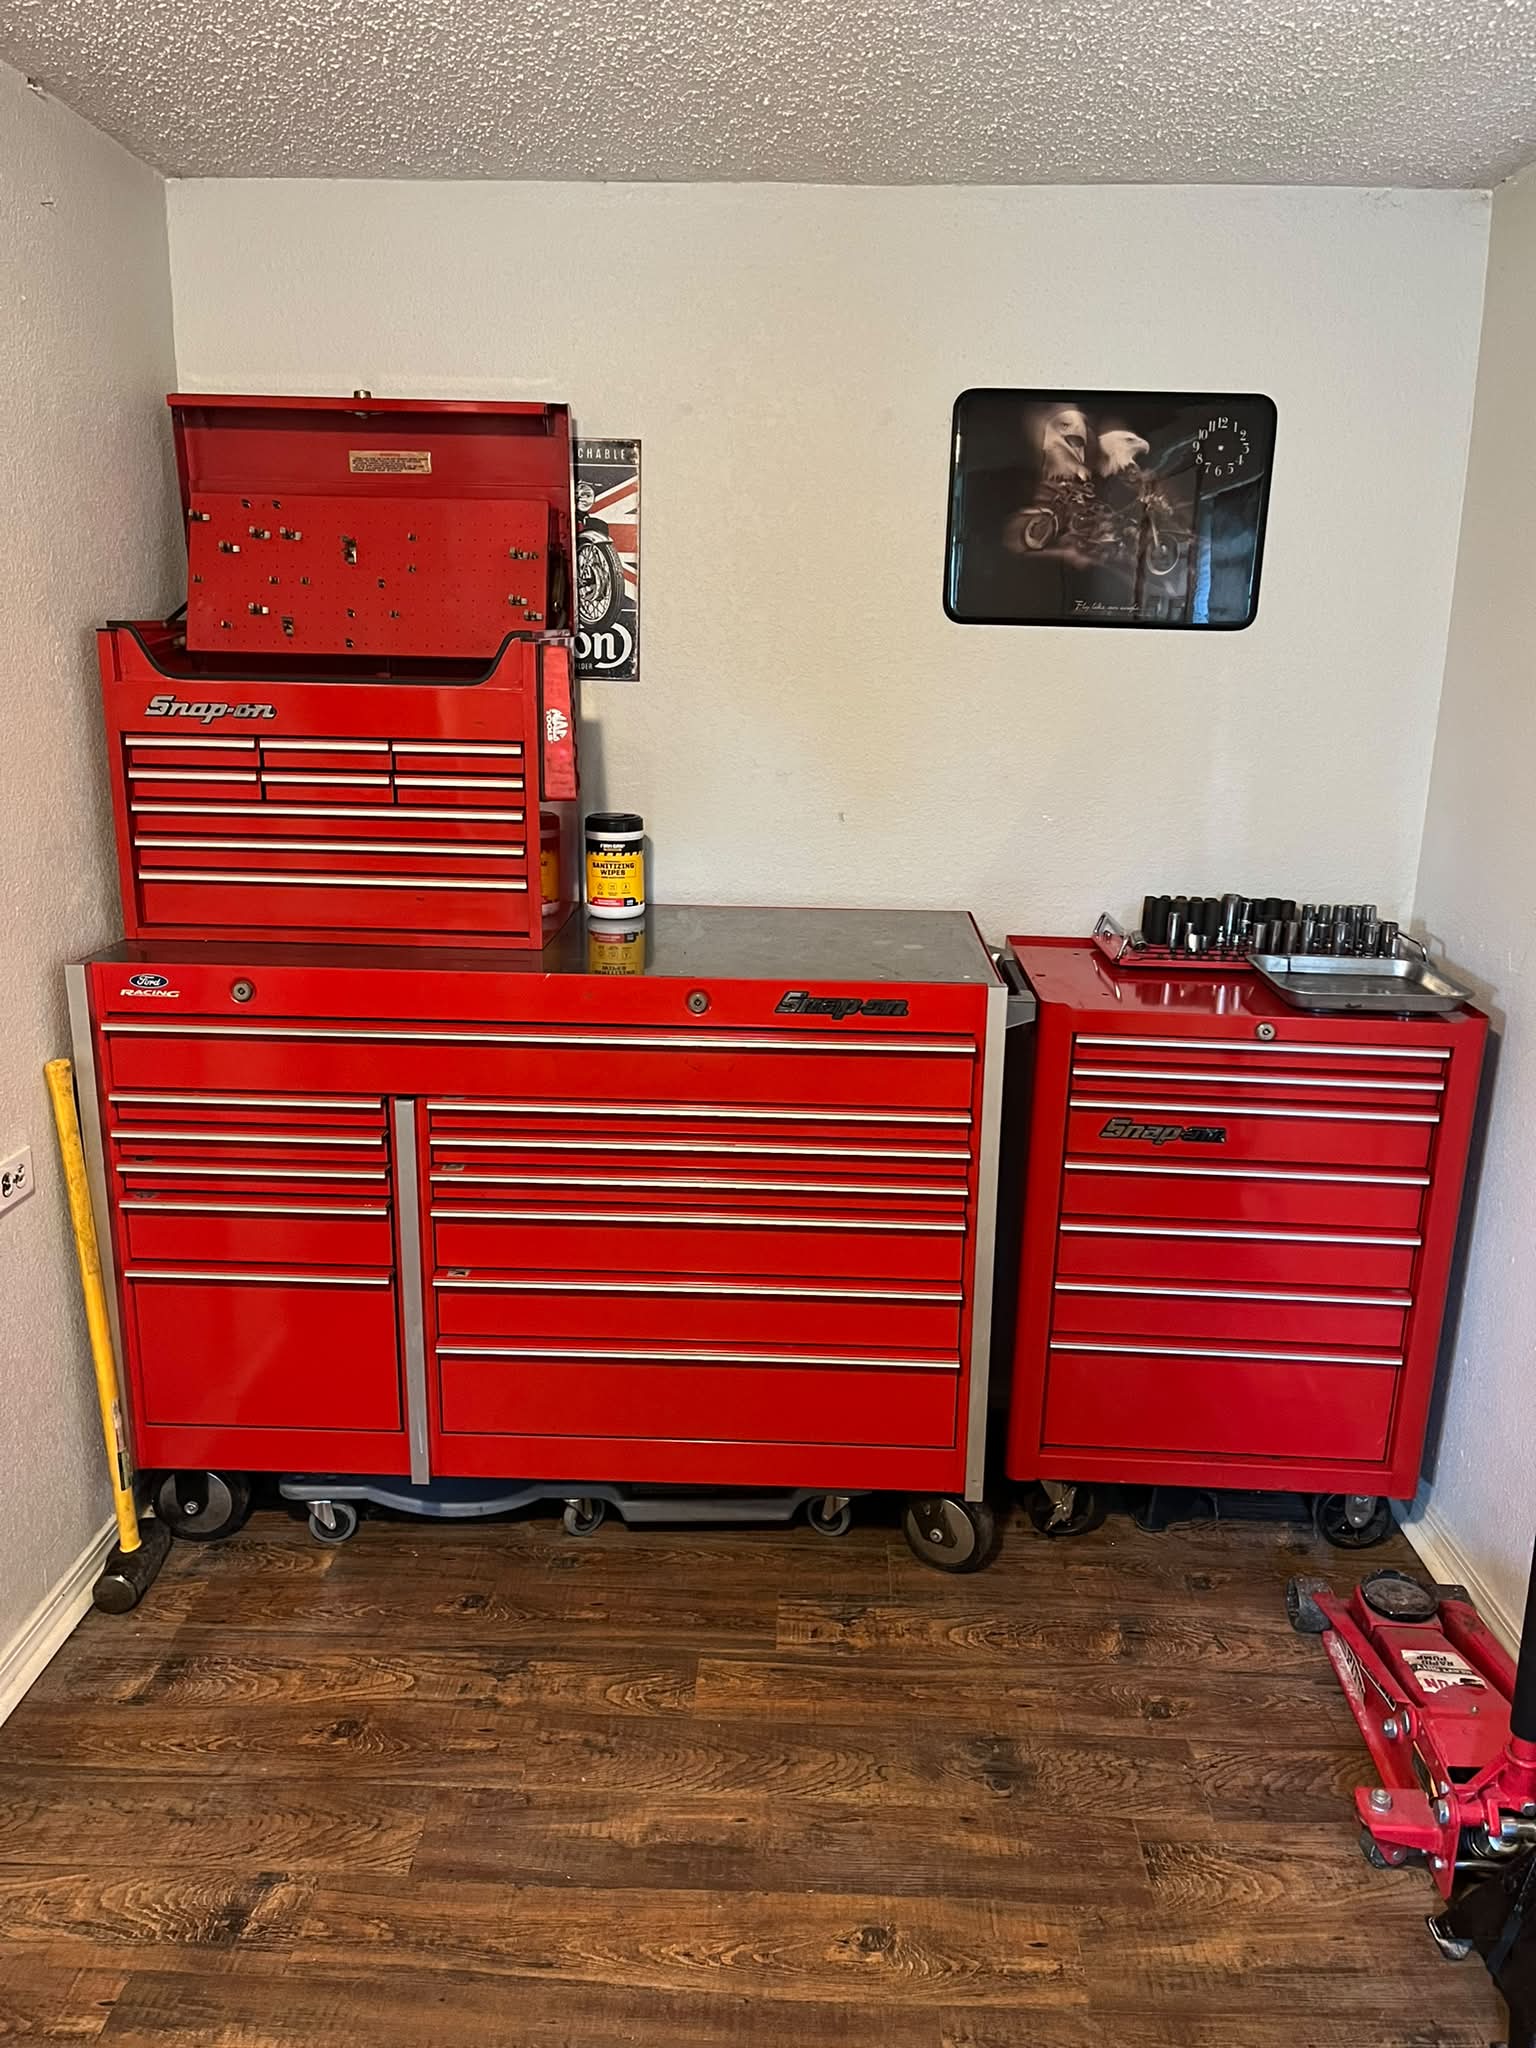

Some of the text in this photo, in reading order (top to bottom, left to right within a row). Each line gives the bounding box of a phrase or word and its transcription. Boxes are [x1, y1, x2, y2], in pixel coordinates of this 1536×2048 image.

[1208, 420, 1216, 432] 11
[1217, 416, 1229, 429] 12
[1233, 421, 1238, 433] 1
[1198, 429, 1208, 440] 10
[1239, 430, 1247, 441] 2
[1192, 441, 1200, 452] 9
[1242, 442, 1250, 454] 3
[577, 447, 625, 460] CHABLE
[1195, 453, 1203, 465] 8
[1235, 454, 1244, 465] 4
[1204, 462, 1212, 474] 7
[1214, 465, 1222, 476] 6
[1227, 462, 1234, 474] 5
[144, 695, 276, 725] Snap-on
[592, 861, 635, 869] SANITIZING
[136, 975, 161, 986] Ford
[120, 988, 180, 998] RACING
[774, 990, 909, 1020] Snap-on
[1099, 1116, 1226, 1146] Snap-on
